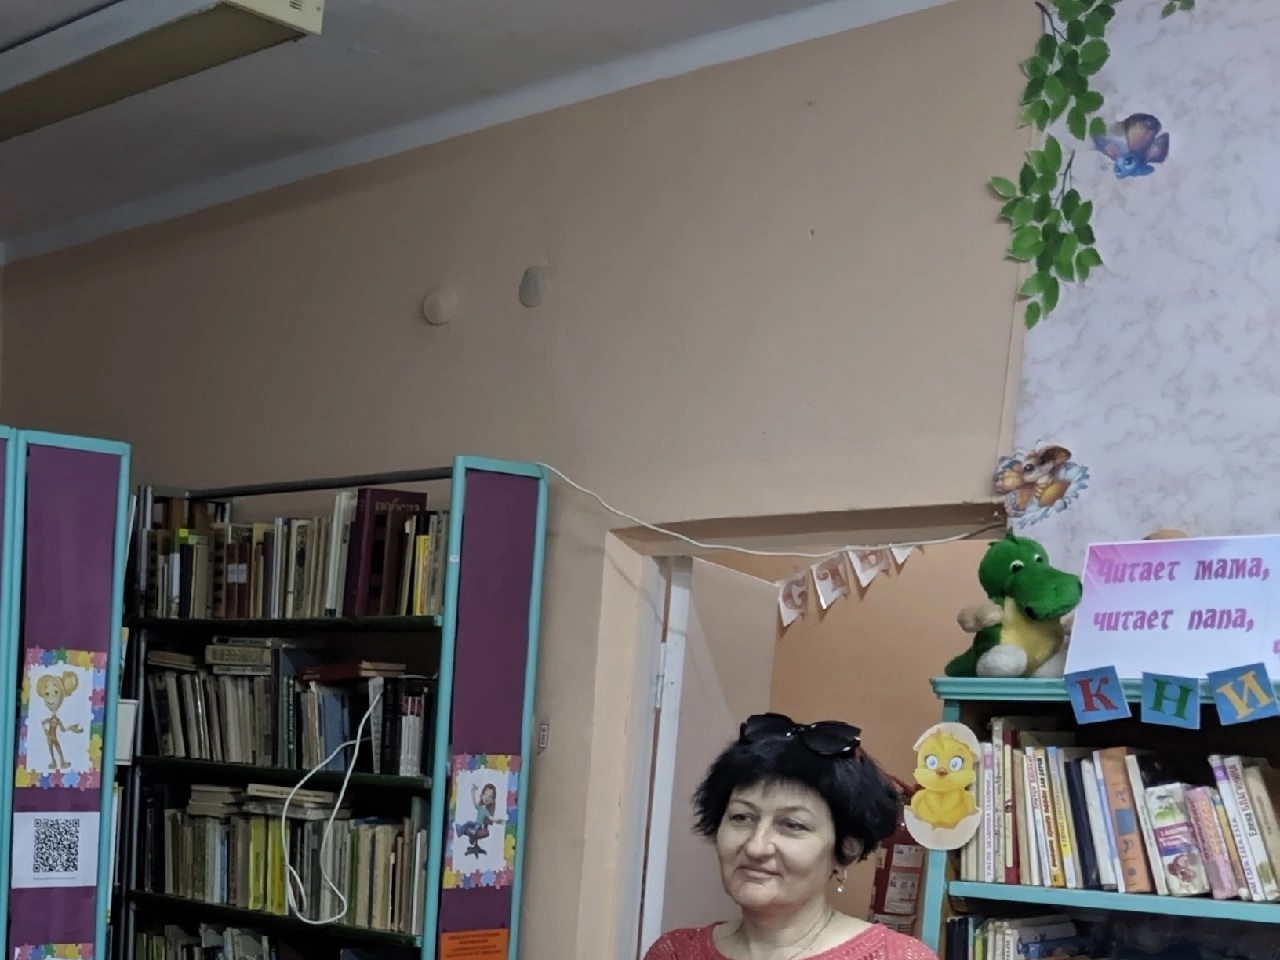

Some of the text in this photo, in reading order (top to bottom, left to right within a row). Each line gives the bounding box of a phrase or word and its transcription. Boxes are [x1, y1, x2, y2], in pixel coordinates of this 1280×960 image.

[1096, 556, 1271, 584] Читает мама,
[1093, 608, 1255, 633] читает папа,
